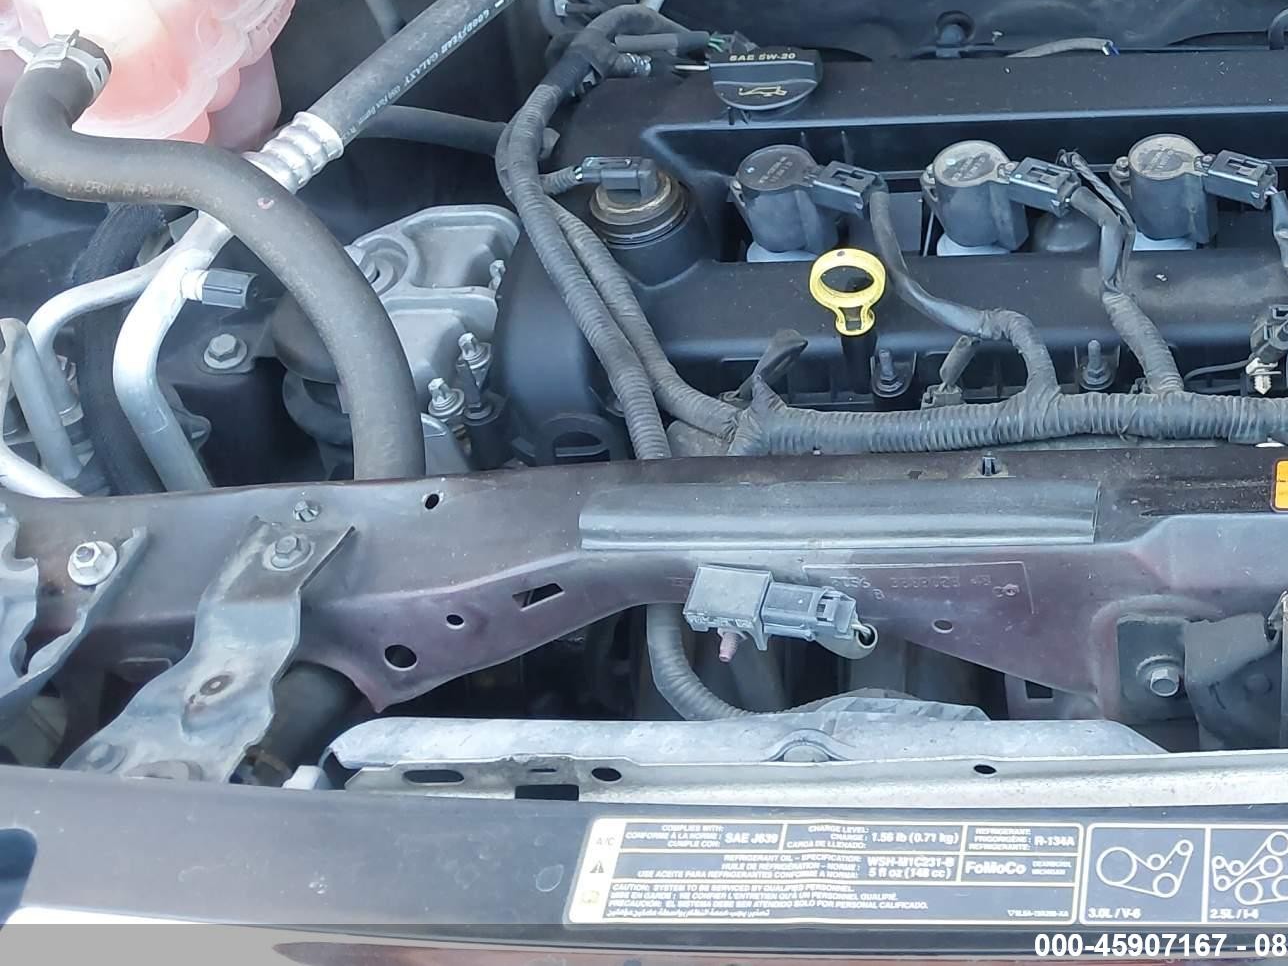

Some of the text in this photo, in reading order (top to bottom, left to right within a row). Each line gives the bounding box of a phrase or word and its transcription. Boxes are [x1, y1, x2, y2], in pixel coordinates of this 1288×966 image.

[728, 52, 797, 62] SAE 5W-20
[725, 833, 749, 844] SAE
[896, 832, 908, 843] lb
[939, 833, 959, 845] kg)
[1034, 836, 1076, 846] R-134A
[964, 861, 1027, 875] FoMoCo
